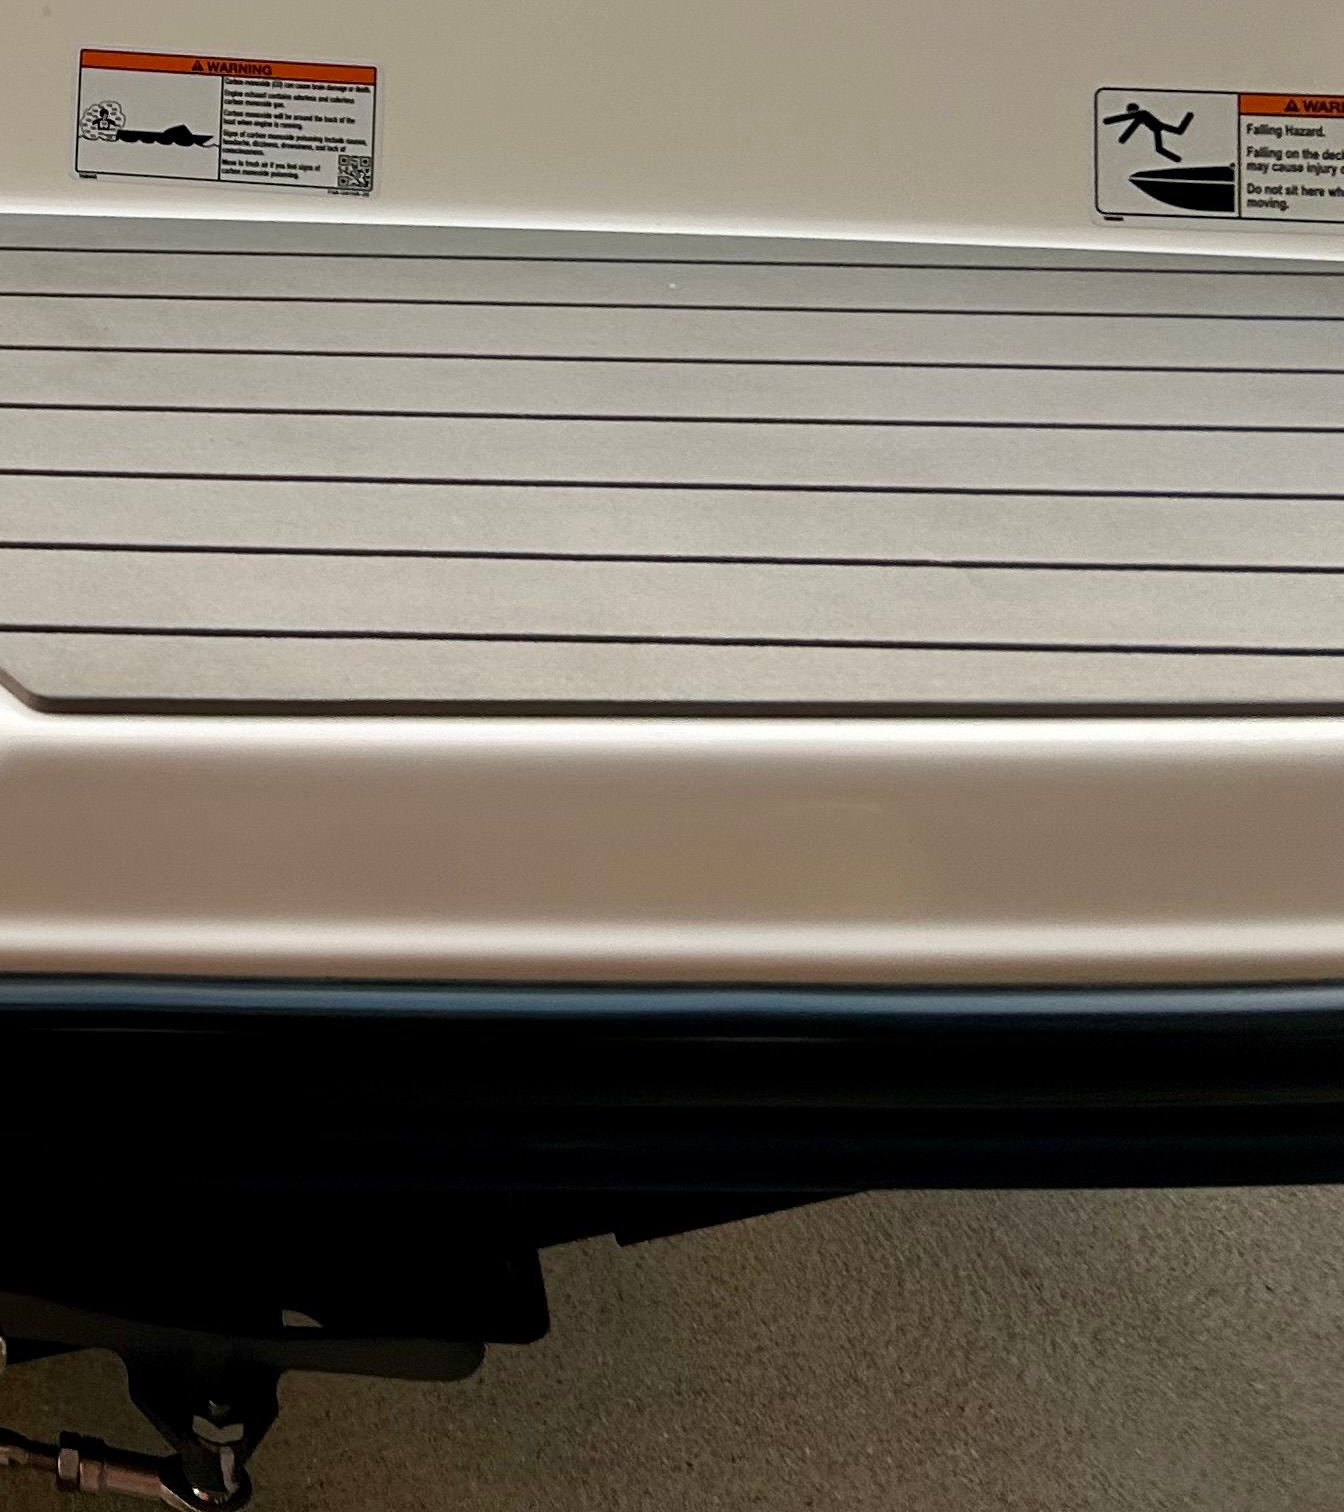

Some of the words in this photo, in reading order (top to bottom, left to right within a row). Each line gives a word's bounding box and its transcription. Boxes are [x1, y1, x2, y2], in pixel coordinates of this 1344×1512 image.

[207, 62, 272, 74] WARNING
[1301, 100, 1344, 112] WAR
[1246, 123, 1283, 138] Falling
[1246, 146, 1283, 160] Falling
[1285, 150, 1299, 158] on
[1301, 149, 1320, 159] the
[1246, 162, 1269, 173] may
[1271, 164, 1304, 172] cause
[1306, 162, 1338, 175] injury
[1246, 182, 1262, 194] Do
[1264, 185, 1283, 195] not
[1284, 185, 1298, 195] sit
[1301, 185, 1325, 196] here
[1246, 198, 1289, 210] moving.
